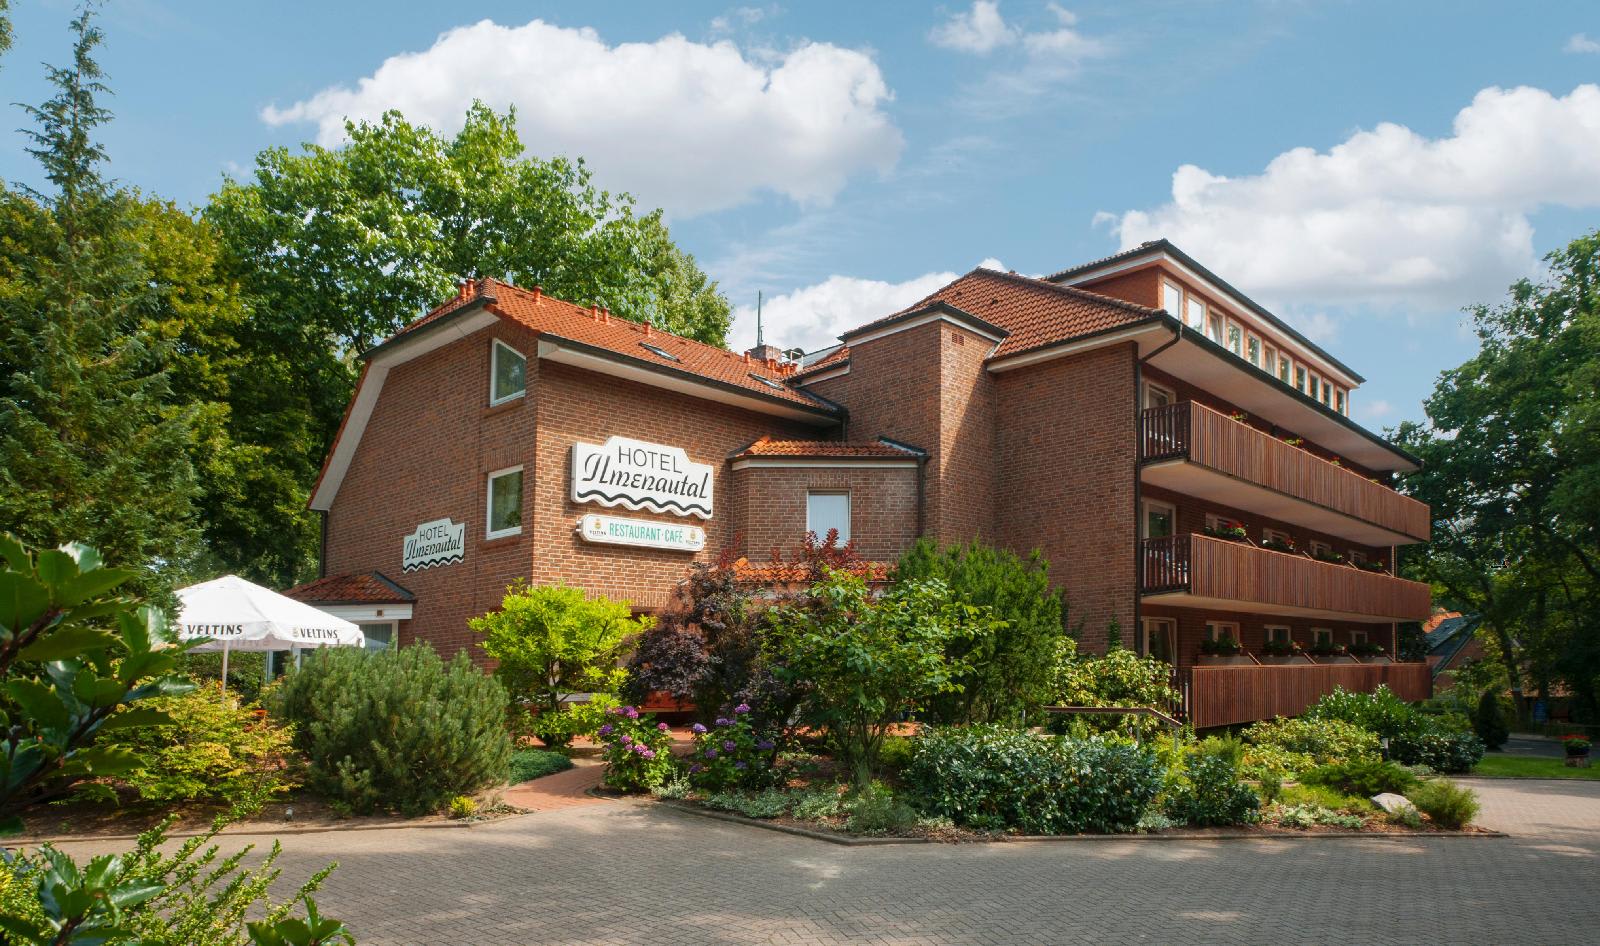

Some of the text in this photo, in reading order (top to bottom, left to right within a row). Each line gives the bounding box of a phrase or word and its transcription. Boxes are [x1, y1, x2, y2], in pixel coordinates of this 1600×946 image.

[618, 446, 683, 474] HOTEL
[582, 452, 709, 499] Ilmenautal
[405, 529, 462, 560] Ilmenautal
[419, 525, 449, 542] HOTEL
[187, 624, 243, 635] VELTINS
[300, 628, 338, 639] VELTINS
